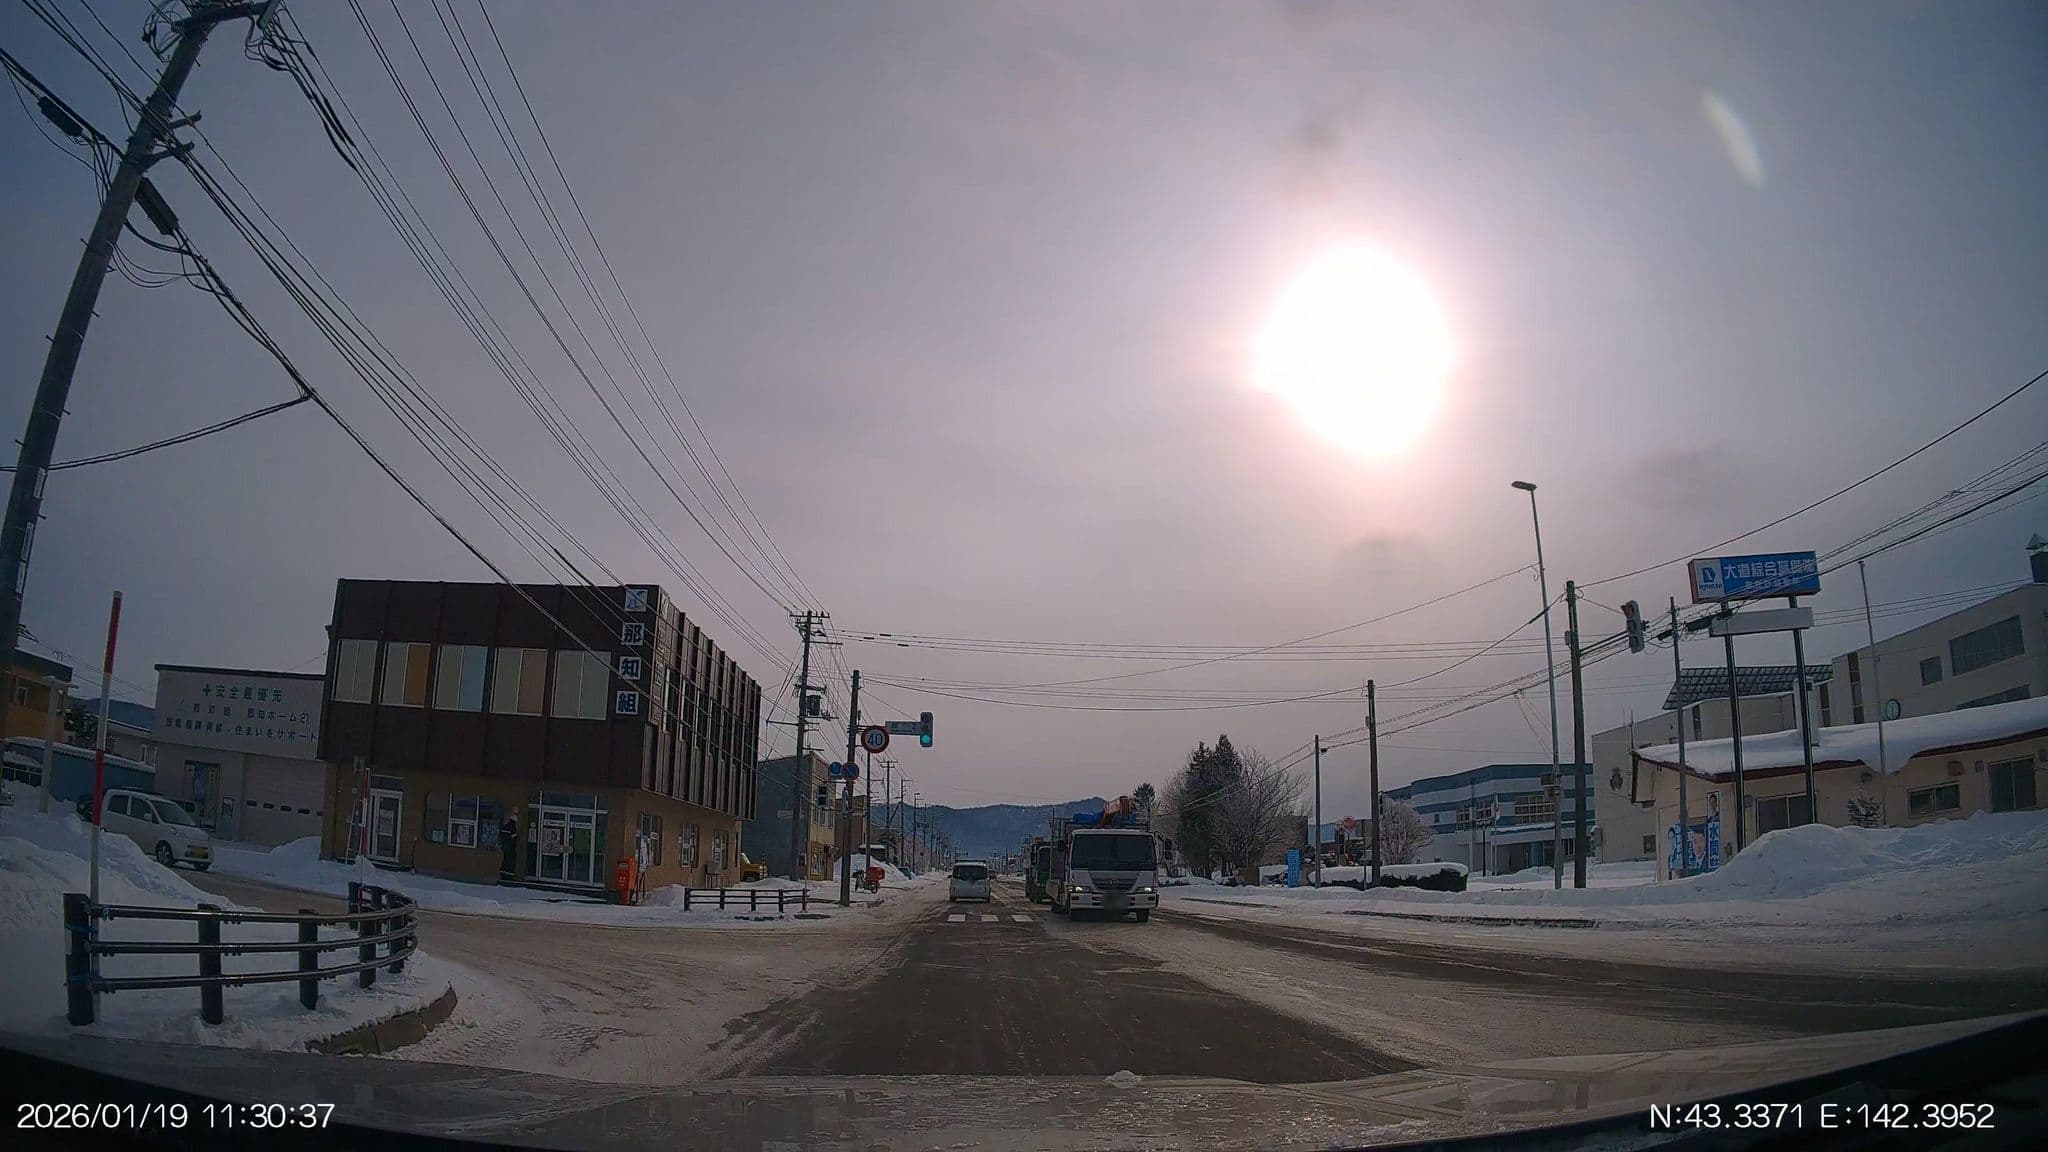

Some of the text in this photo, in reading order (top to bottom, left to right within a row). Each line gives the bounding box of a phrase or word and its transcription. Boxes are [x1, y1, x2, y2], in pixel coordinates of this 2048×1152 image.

[618, 623, 643, 713] 那知組
[867, 733, 883, 746] 40
